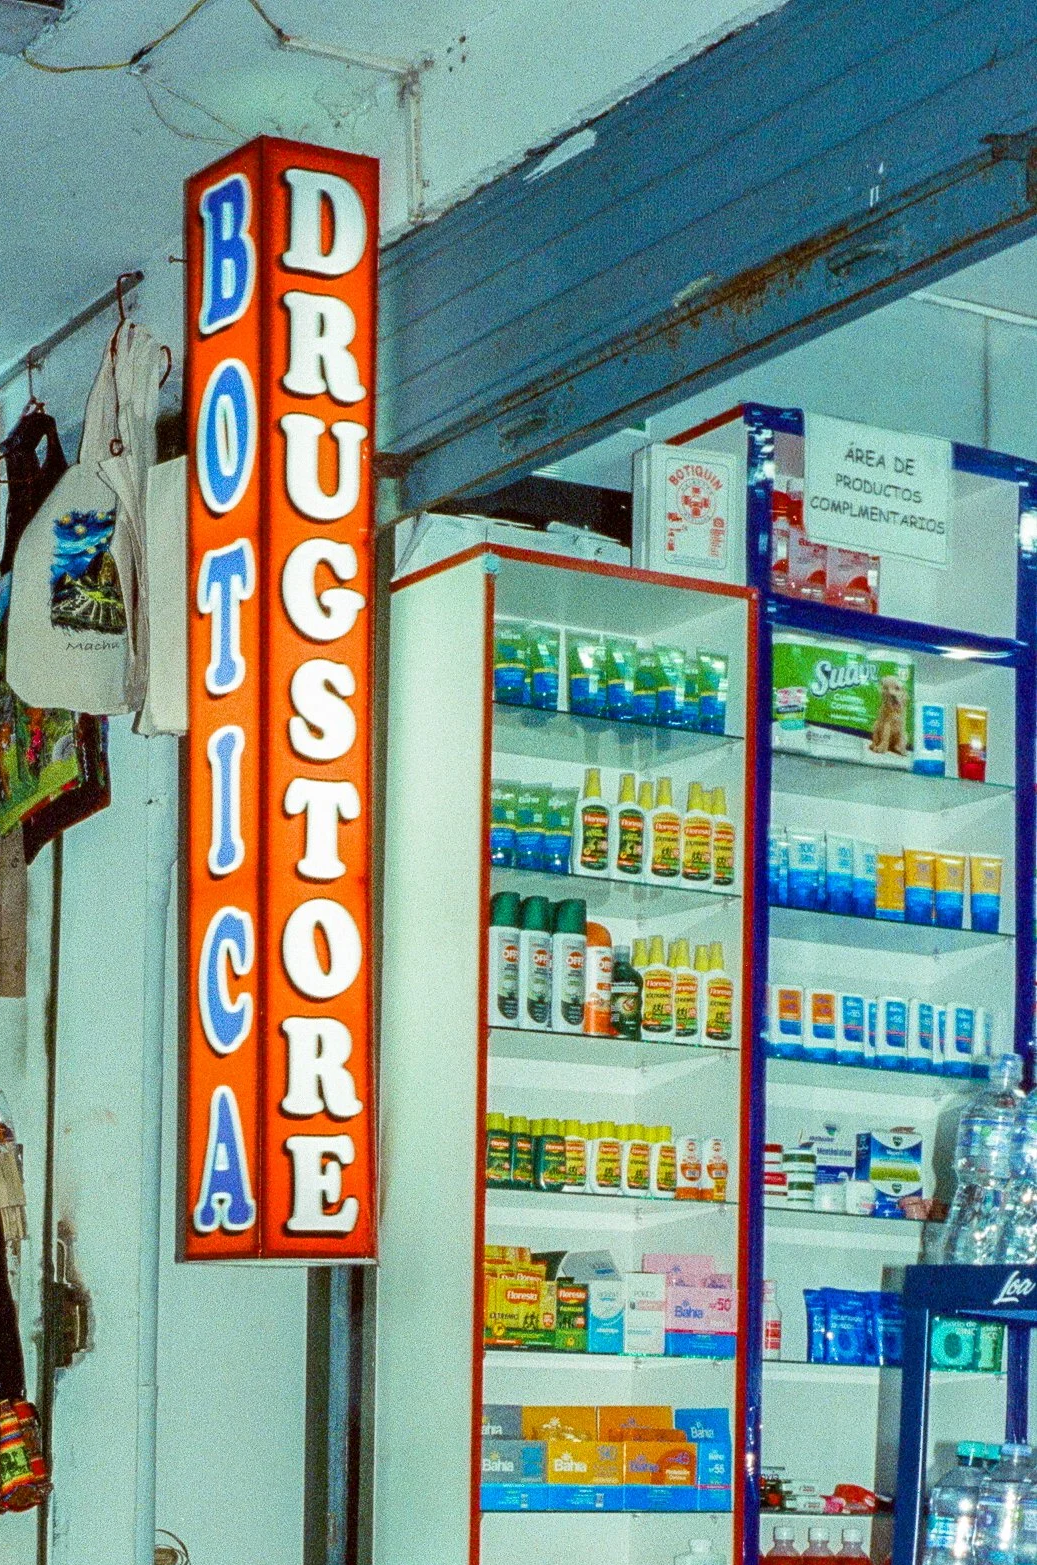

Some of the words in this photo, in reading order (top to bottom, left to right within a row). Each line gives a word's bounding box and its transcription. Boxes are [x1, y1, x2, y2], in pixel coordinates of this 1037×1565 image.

[844, 442, 886, 469] ÁREA
[894, 457, 916, 476] DE
[668, 465, 723, 491] BOTIQUIN
[835, 473, 923, 504] PRODUCTOS
[195, 171, 256, 1237] BOTICA
[282, 168, 364, 1238] DRUGSTORE
